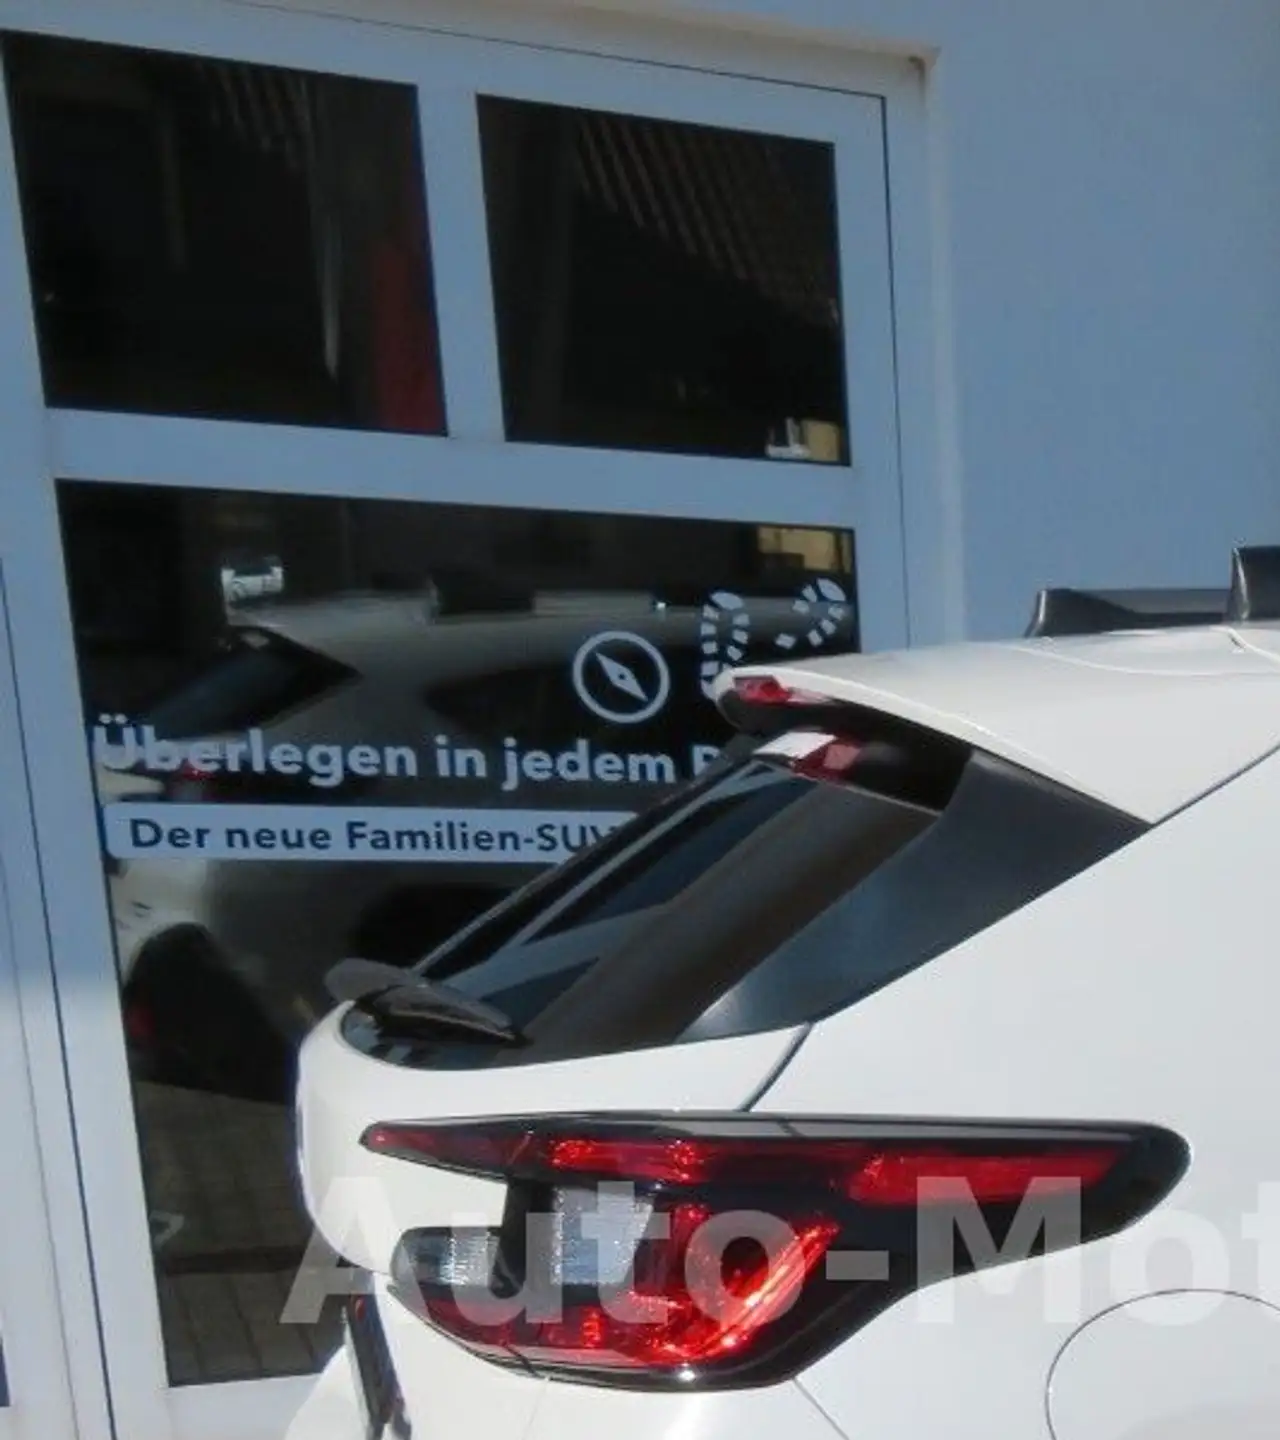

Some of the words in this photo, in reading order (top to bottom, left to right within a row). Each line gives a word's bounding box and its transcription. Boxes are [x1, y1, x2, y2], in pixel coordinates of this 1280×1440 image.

[94, 714, 417, 788] Überlegen
[435, 734, 487, 777] in
[501, 737, 676, 791] jedem
[129, 818, 210, 850] Der
[225, 825, 332, 851] neue
